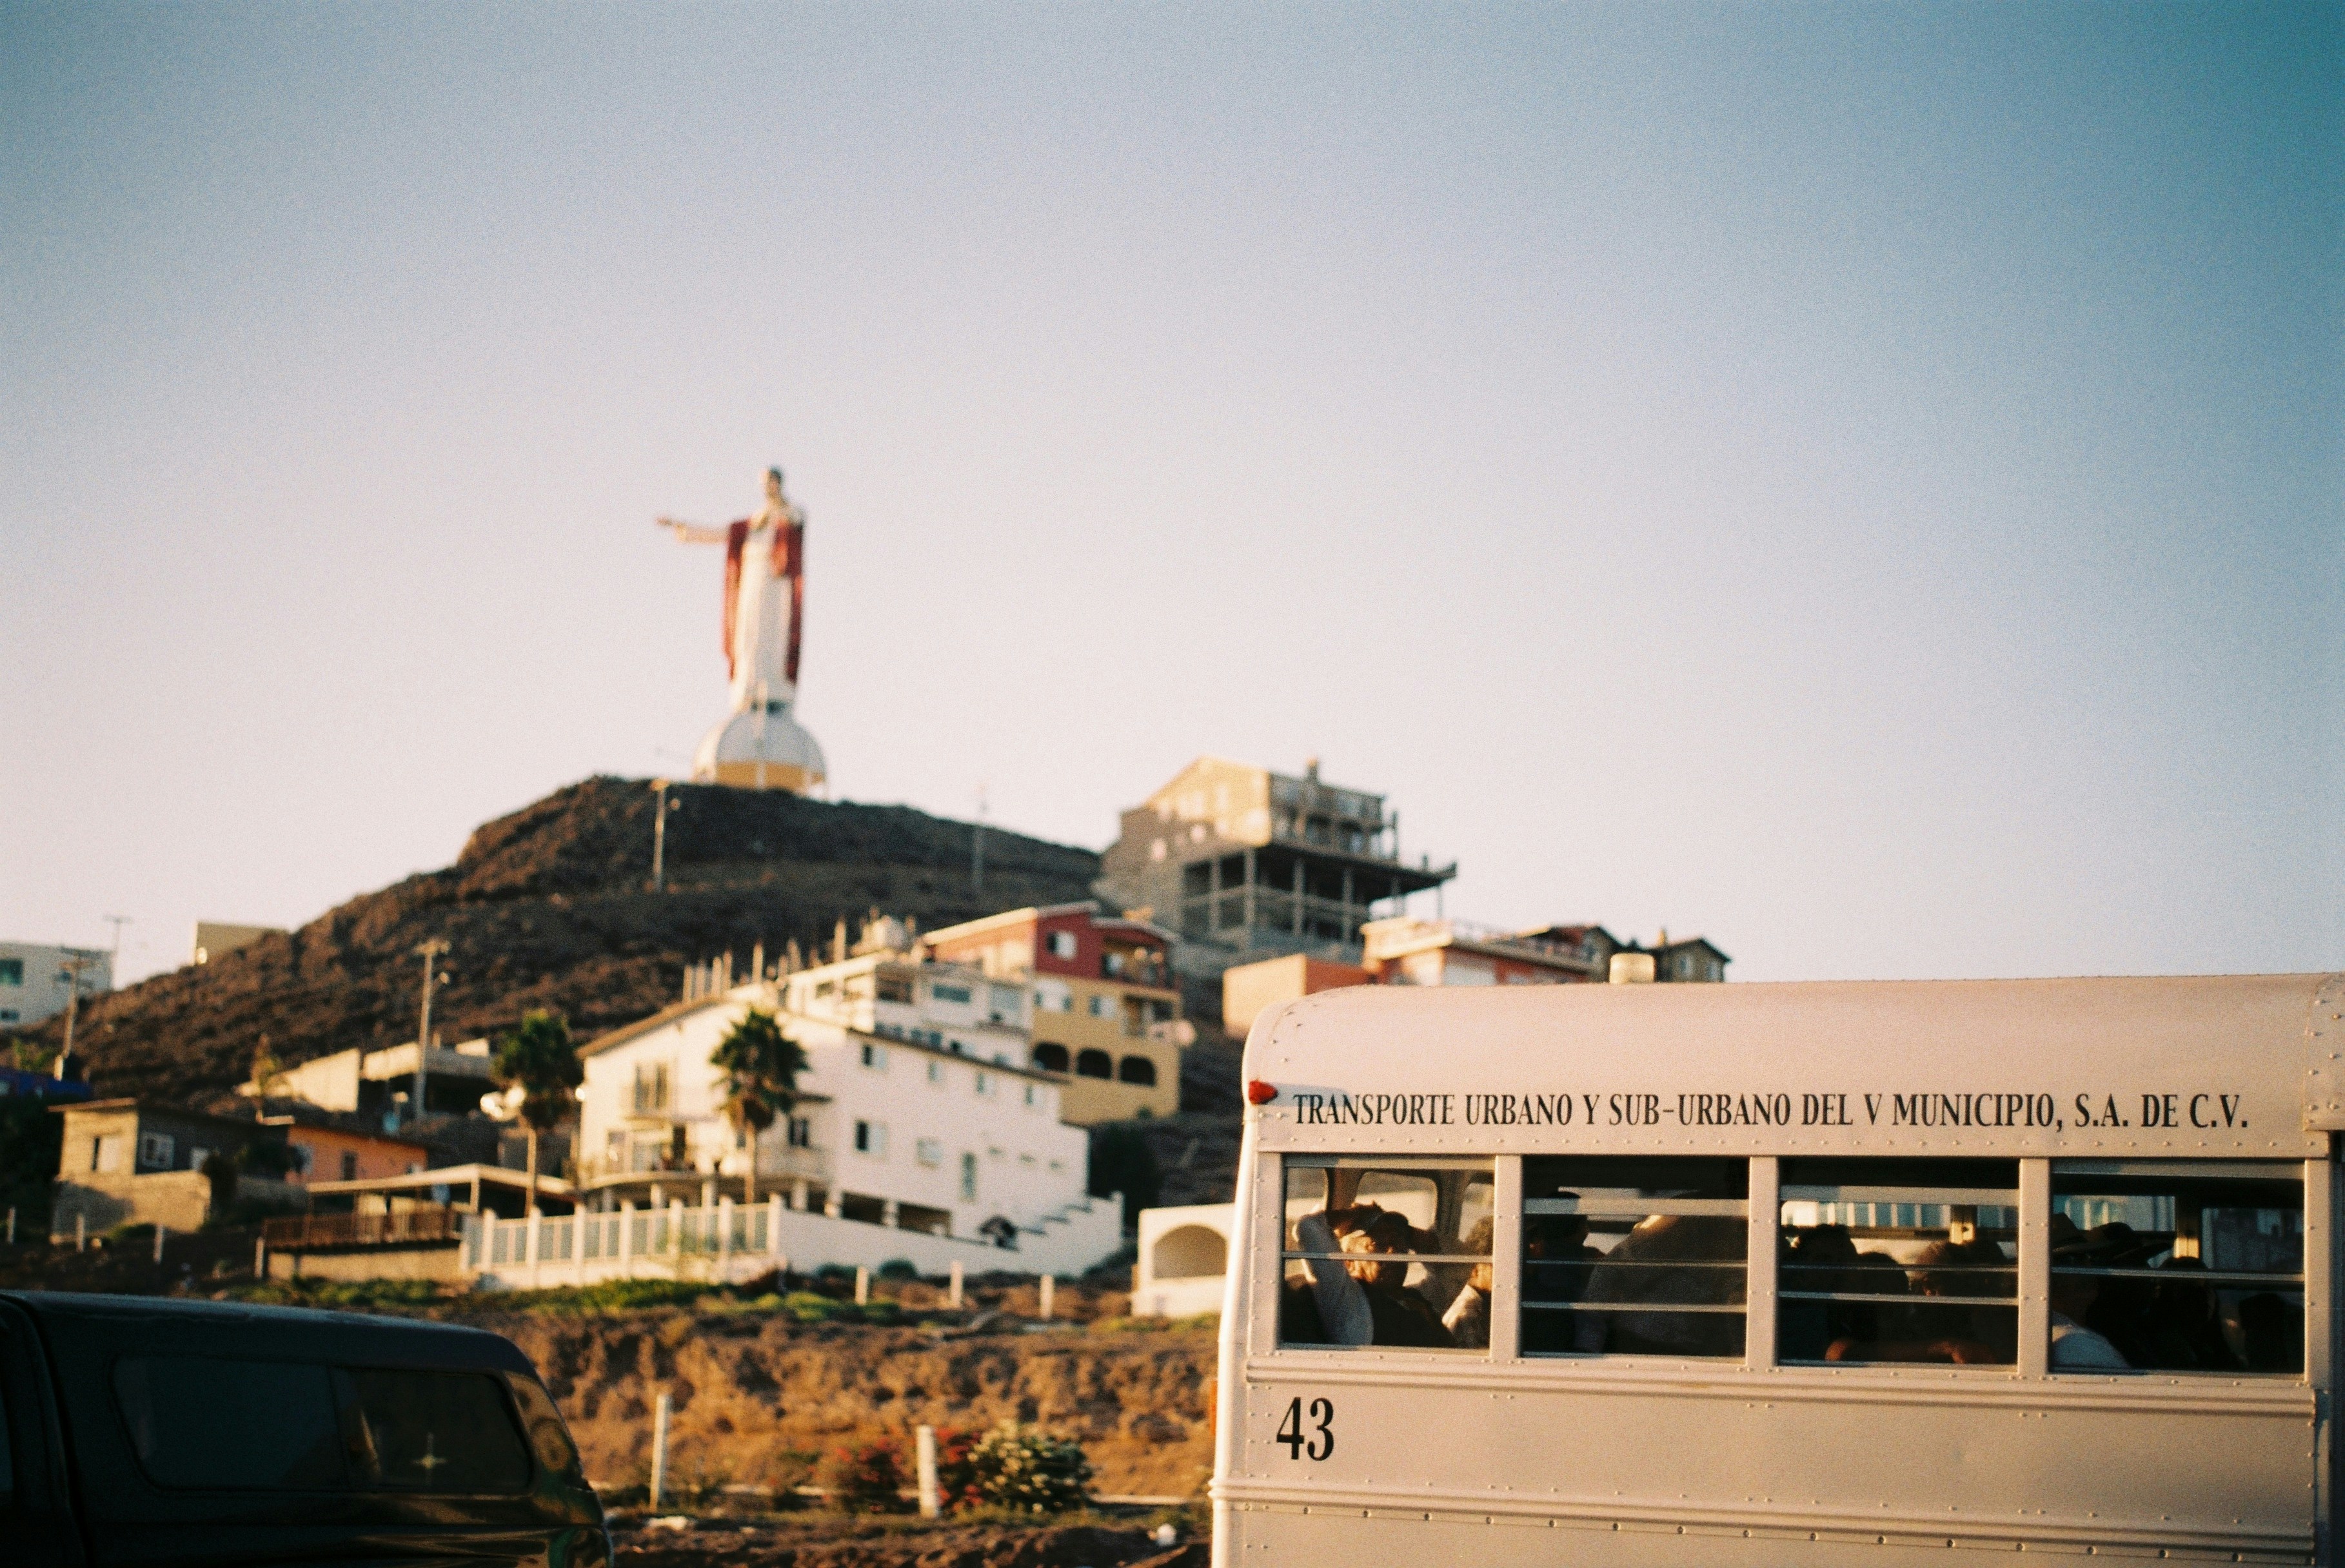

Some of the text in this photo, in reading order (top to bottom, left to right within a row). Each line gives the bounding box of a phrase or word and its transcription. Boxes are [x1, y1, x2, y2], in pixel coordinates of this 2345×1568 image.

[1293, 1093, 2249, 1132] TRANSPORTE URBANO Y SUB-URBANO DEL V MUNICIPIO, S.A. DE C.V.
[1276, 1396, 1334, 1461] 43
